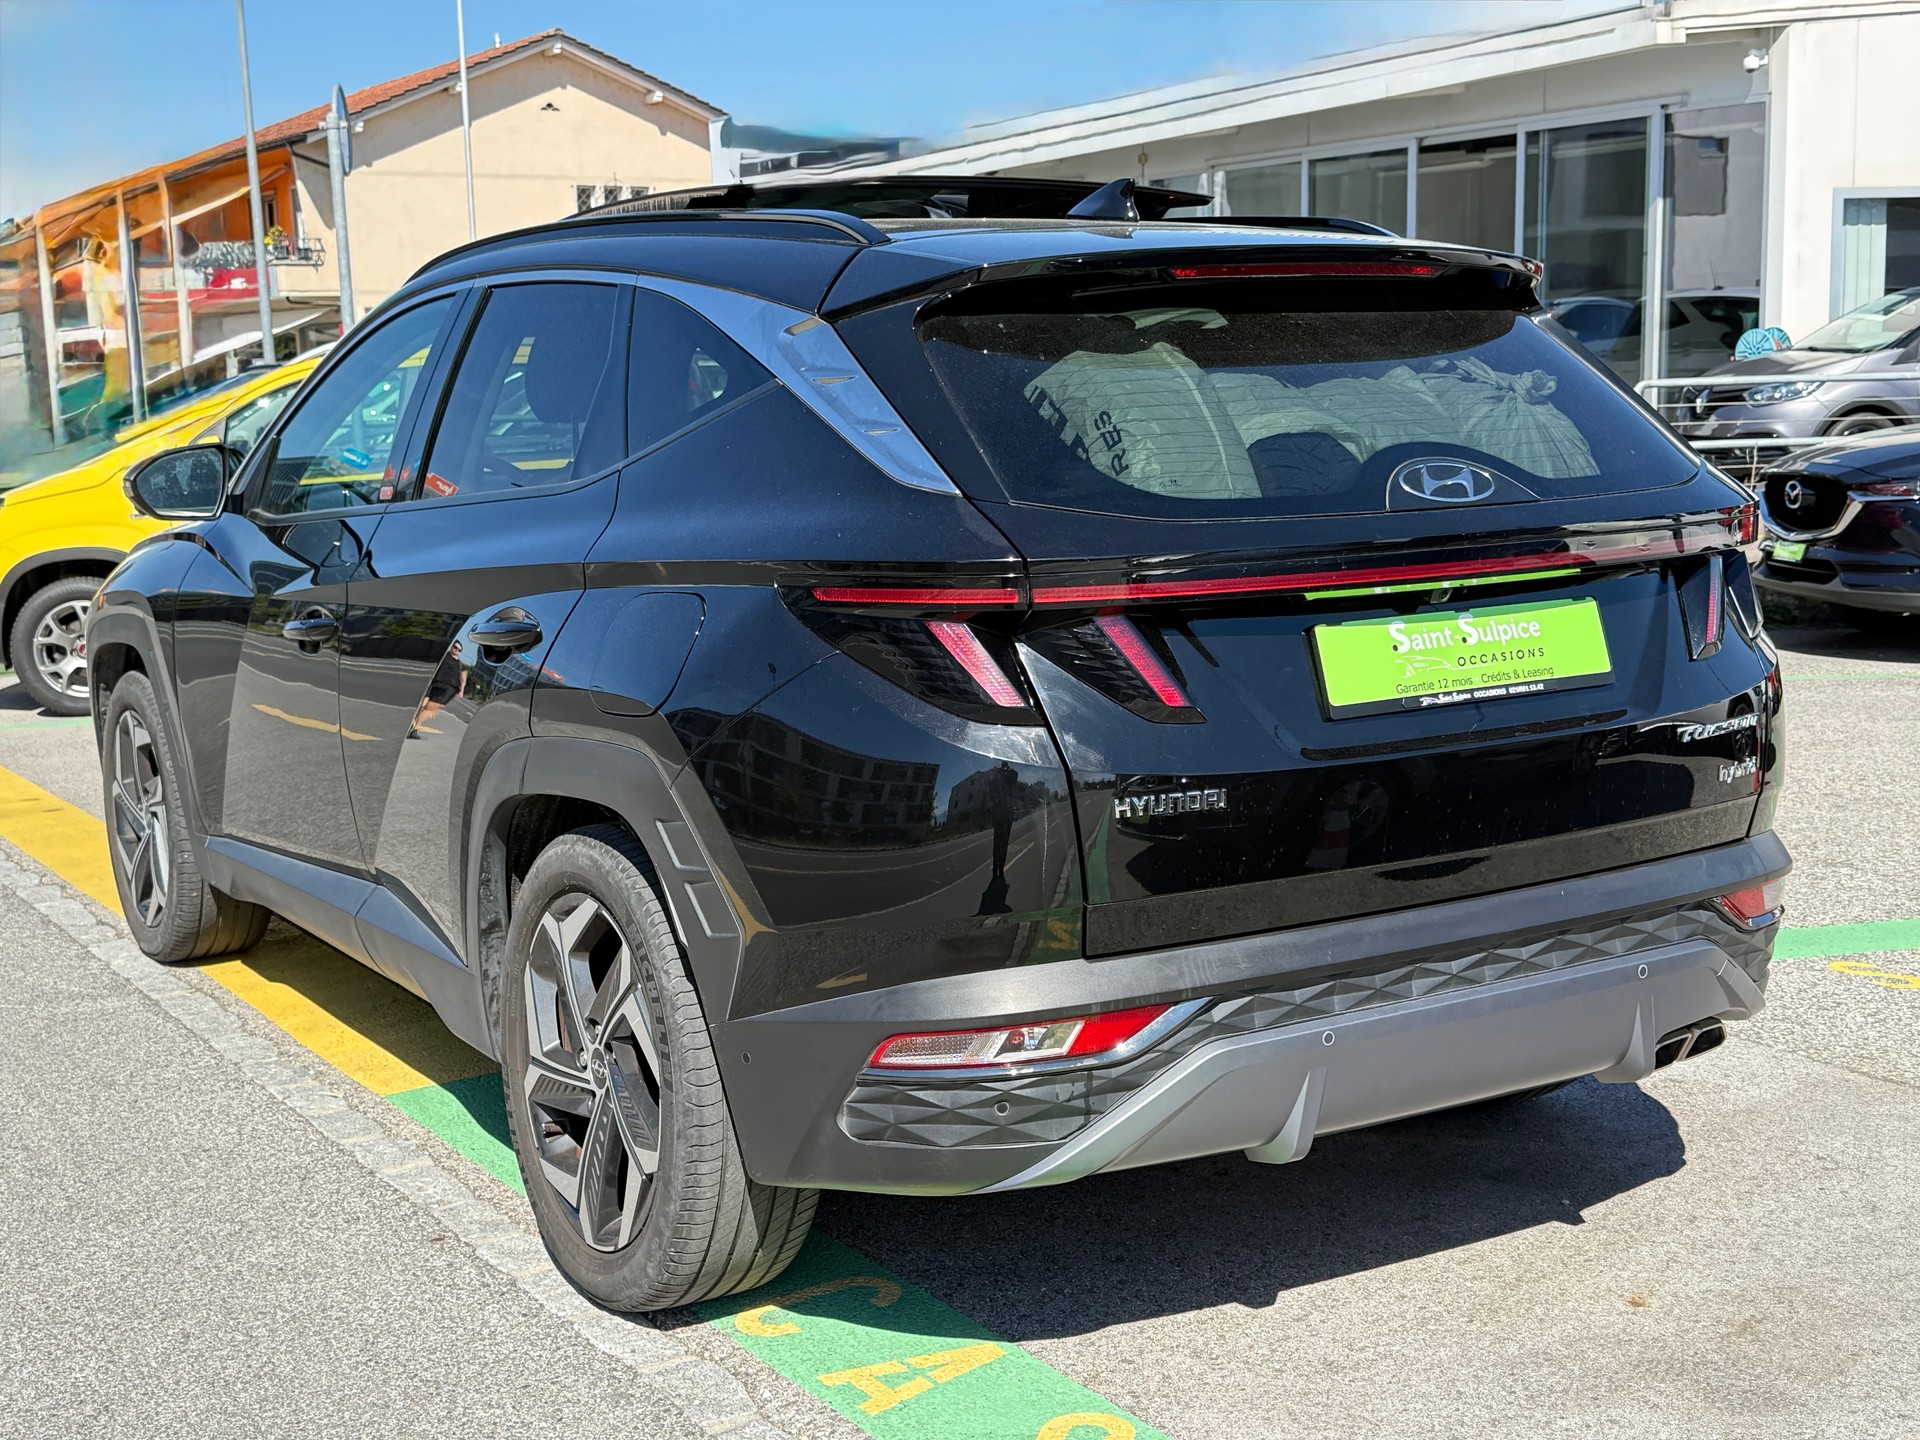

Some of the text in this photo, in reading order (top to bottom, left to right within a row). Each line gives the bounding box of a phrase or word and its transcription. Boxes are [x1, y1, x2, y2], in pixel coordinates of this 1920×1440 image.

[1457, 647, 1545, 667] OCCASIONS
[1396, 666, 1554, 694] Garantie 12 mois Crédits & Leasing
[1114, 788, 1228, 819] HYUNDAI
[626, 921, 674, 1088] MICHELIN
